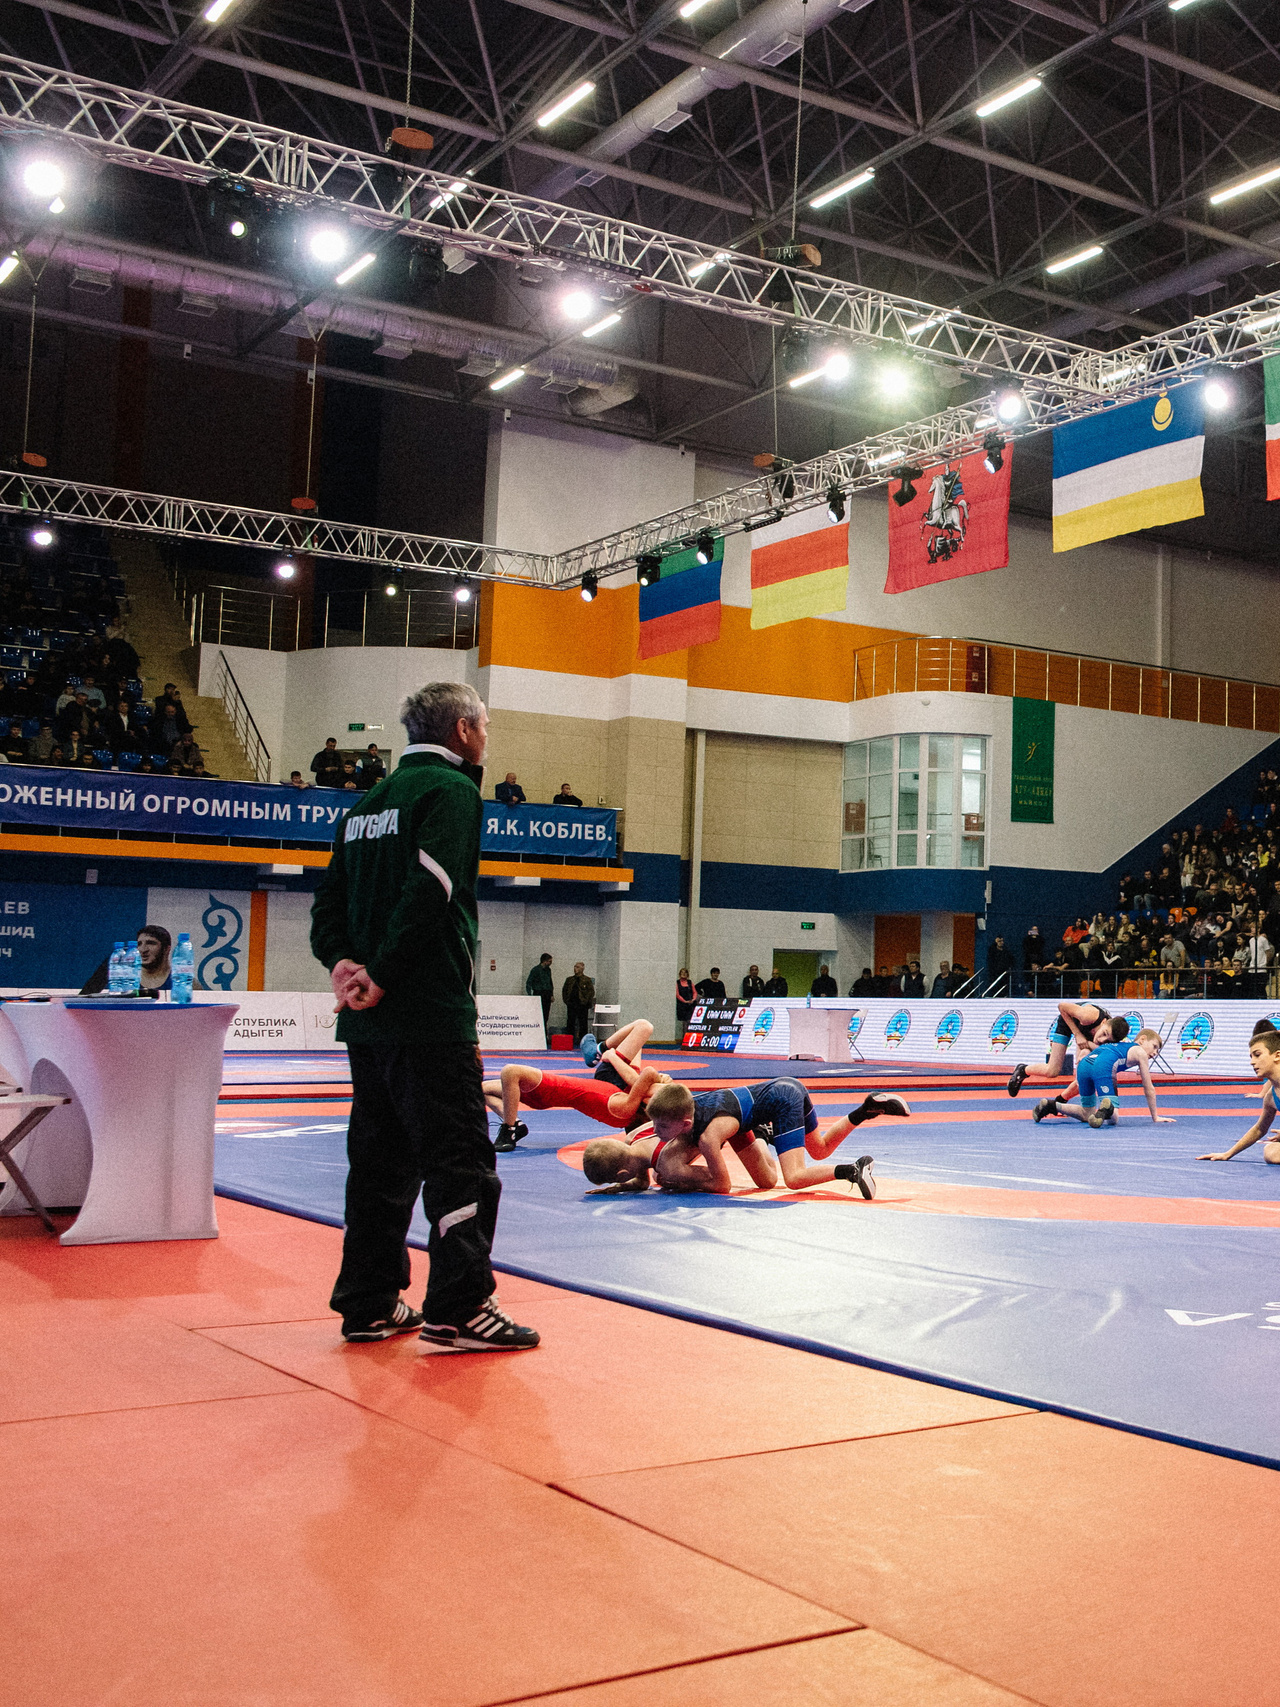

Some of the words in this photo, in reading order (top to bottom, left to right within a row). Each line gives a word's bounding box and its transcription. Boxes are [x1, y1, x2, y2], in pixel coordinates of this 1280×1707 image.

[0, 783, 136, 812] ОЖЕННЫЙ
[142, 794, 292, 821] ОГРОМНЫМ
[486, 817, 525, 837] Я.К.
[529, 820, 613, 842] КОБЛЕВ.
[0, 901, 30, 915] ЕВ
[230, 1018, 297, 1027] СПУБЛИКА
[477, 1021, 540, 1029] Государственный
[233, 1029, 284, 1039] АДЫГЕЯ
[478, 1029, 523, 1037] Университет
[689, 1033, 697, 1048] 0
[700, 1035, 720, 1048] 6:00
[724, 1035, 733, 1049] 0
